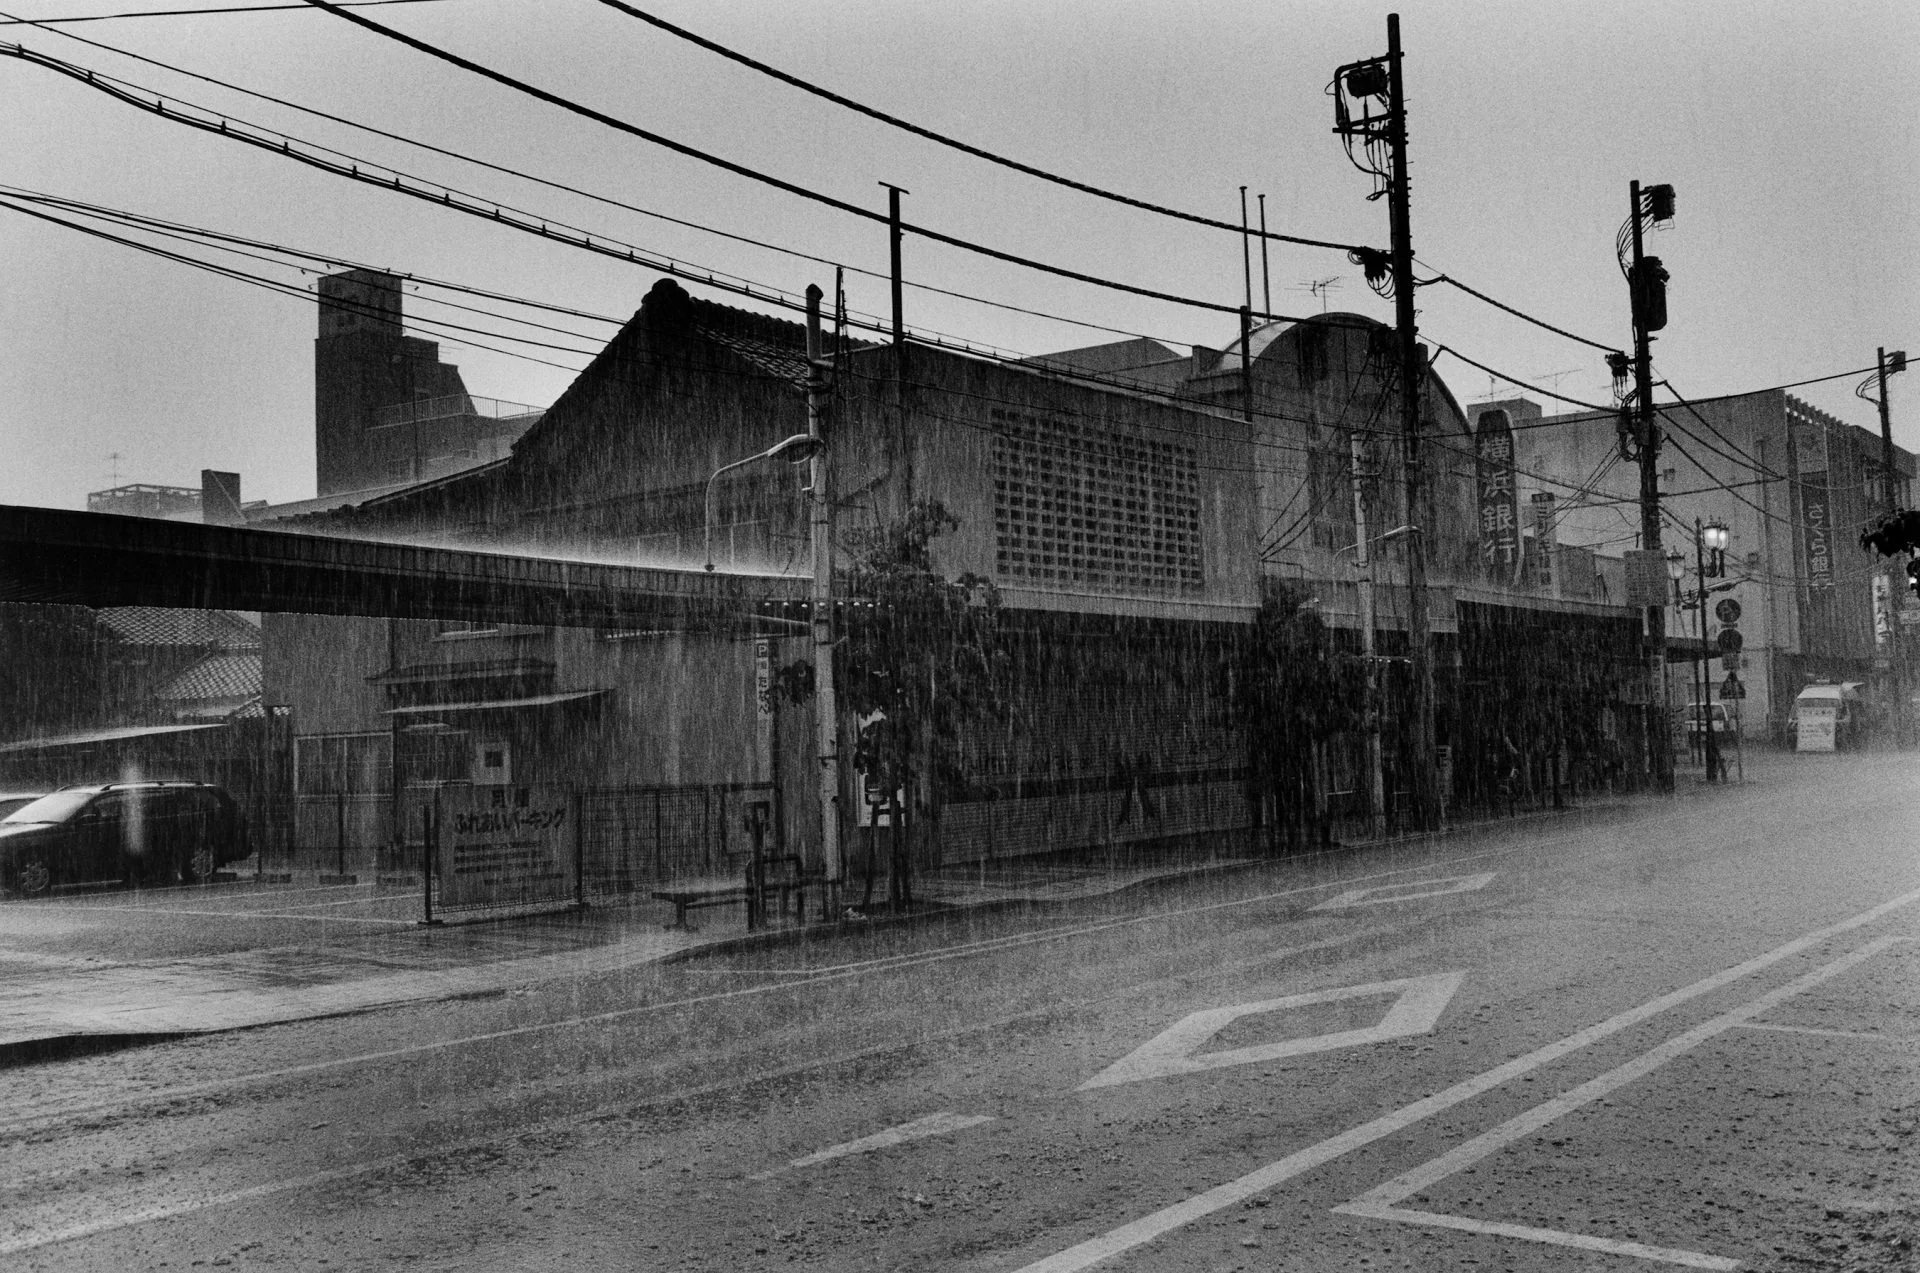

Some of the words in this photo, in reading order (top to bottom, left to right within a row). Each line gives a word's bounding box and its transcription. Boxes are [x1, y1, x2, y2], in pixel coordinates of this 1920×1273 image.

[1479, 436, 1516, 563] 横浜銀行
[1808, 502, 1830, 590] さくら銀行
[758, 644, 767, 657] P
